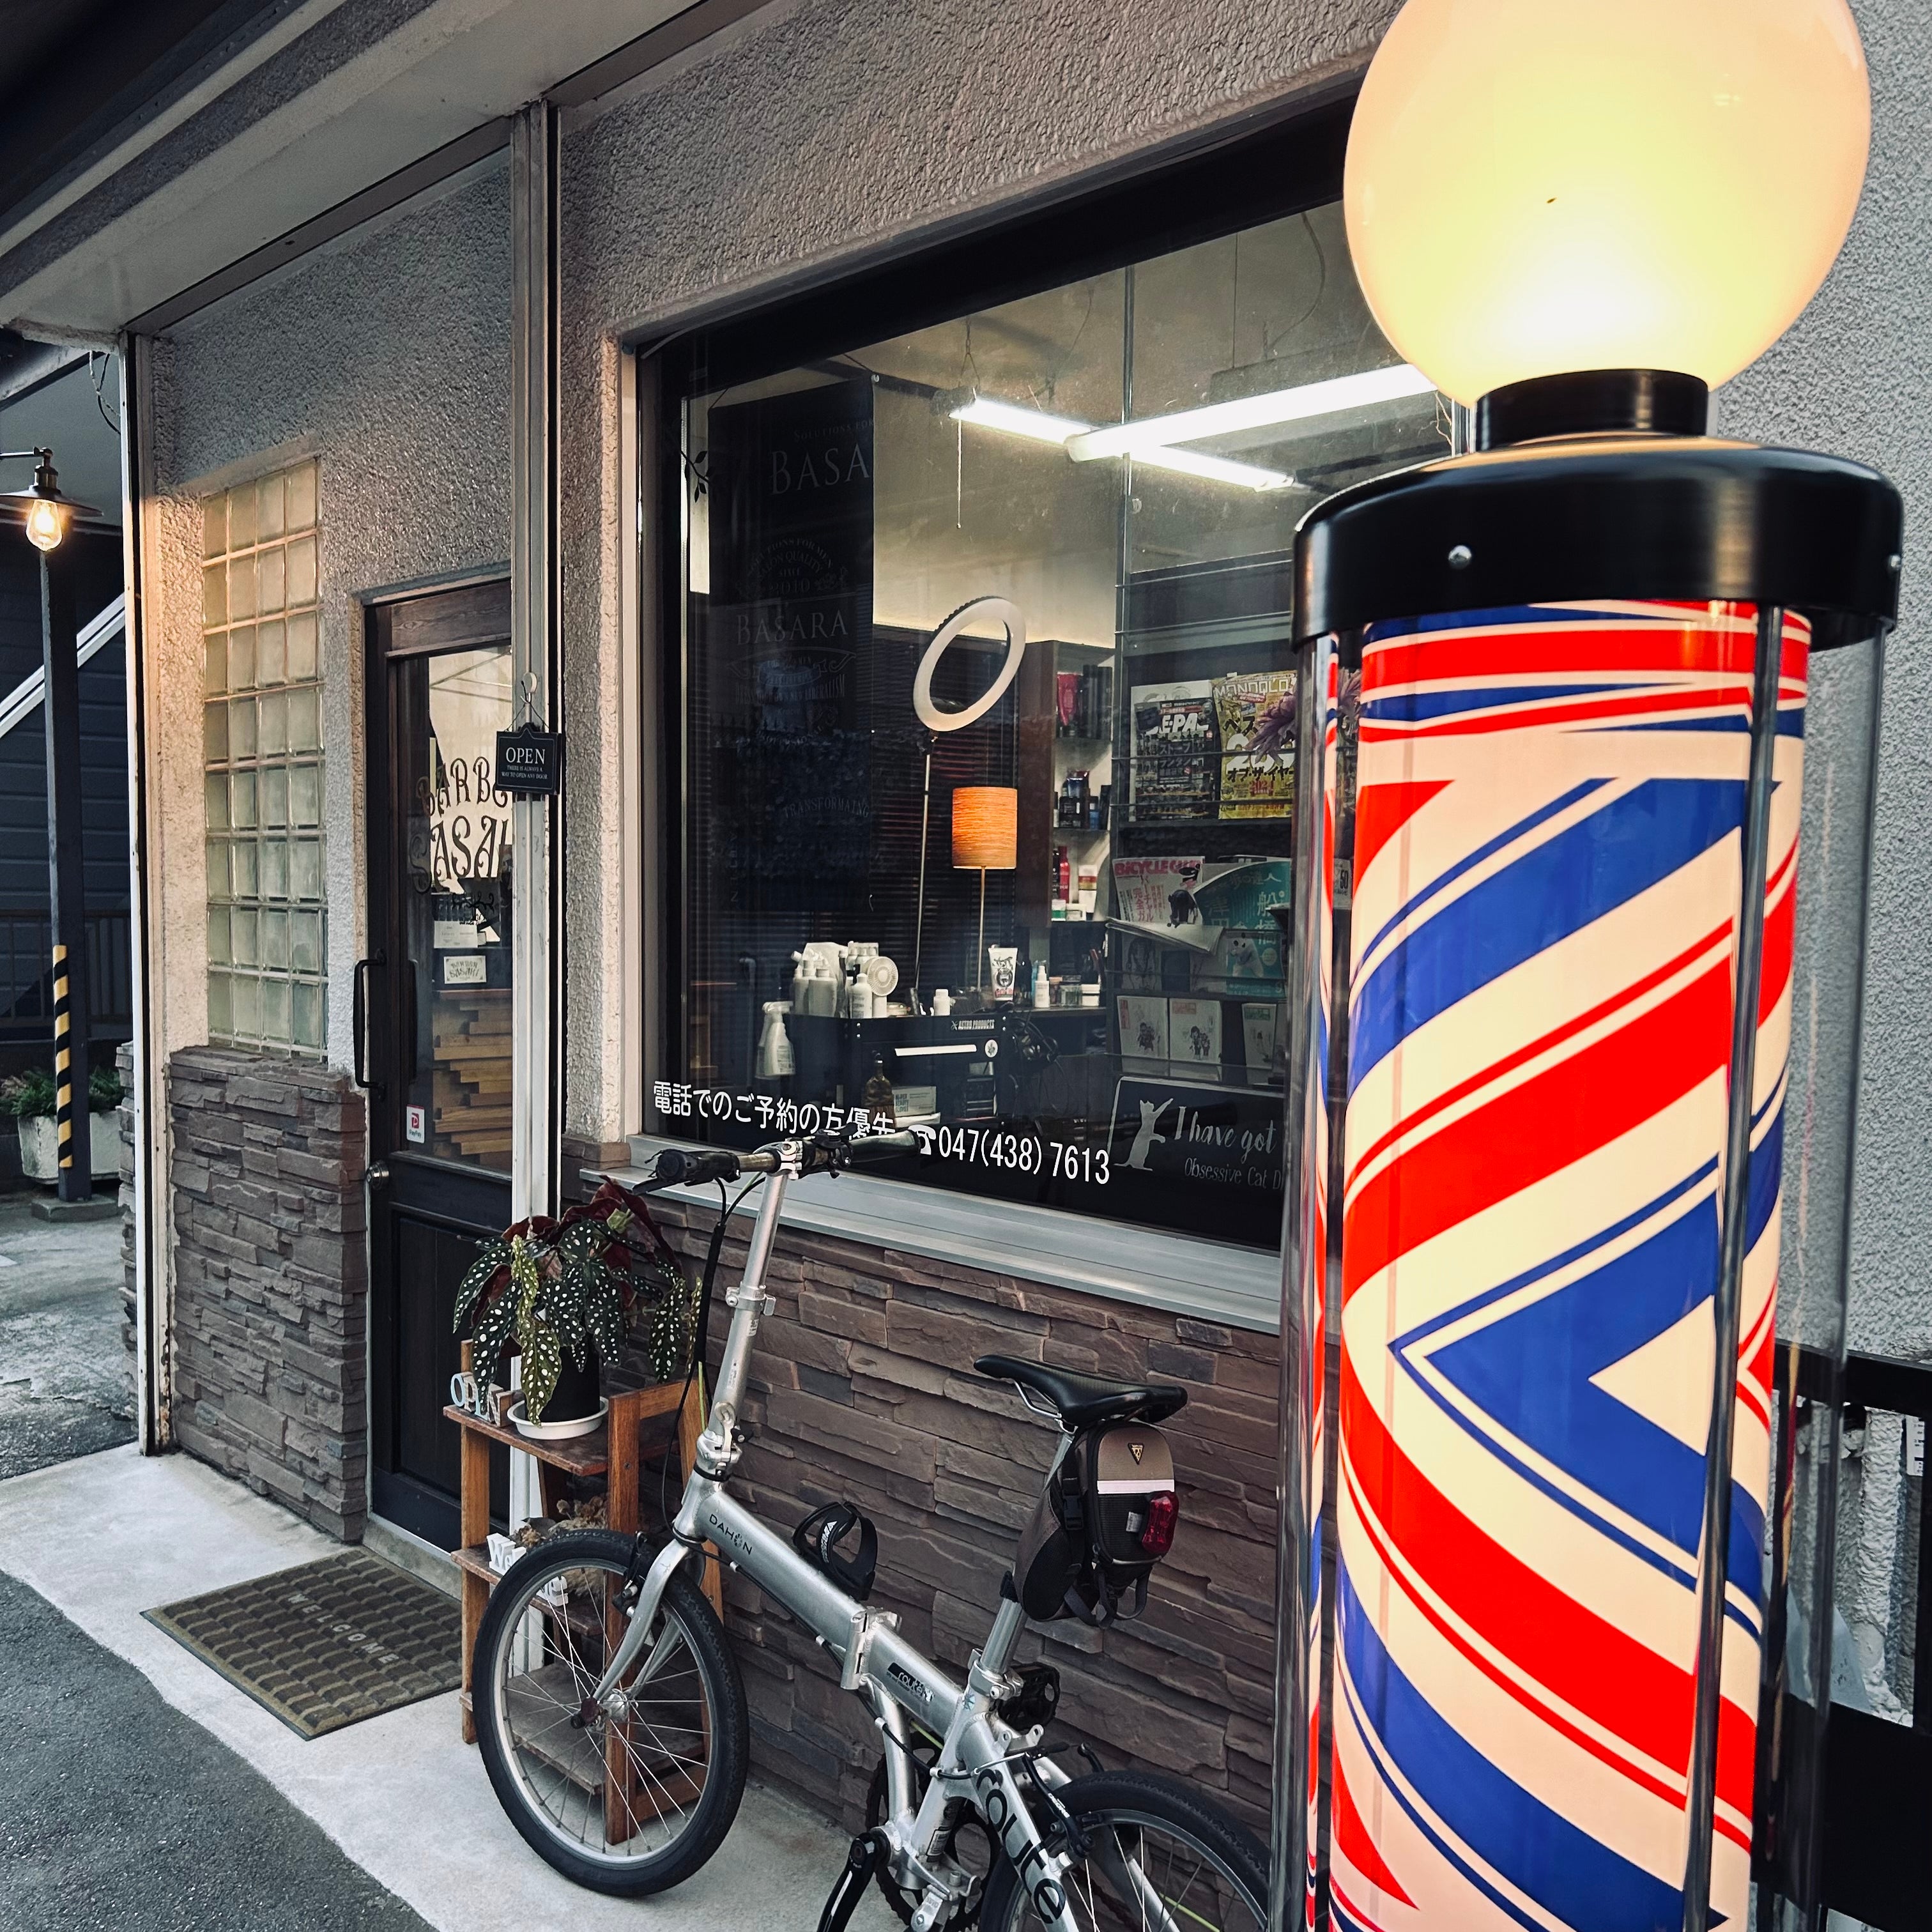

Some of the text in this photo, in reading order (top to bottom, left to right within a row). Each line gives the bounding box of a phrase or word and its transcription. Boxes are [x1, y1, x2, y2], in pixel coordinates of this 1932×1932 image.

[736, 609, 849, 646] BASARA
[505, 746, 546, 765] OPEN
[654, 1081, 896, 1141] 電話でのご予約の方優先
[409, 1129, 422, 1138] PayPay
[1174, 1106, 1276, 1164] I have got
[1184, 1157, 1284, 1190] Obsessive Cat D
[709, 1514, 753, 1555] DAHON
[288, 1593, 399, 1664] WELCOME
[976, 1768, 1066, 1924] route
